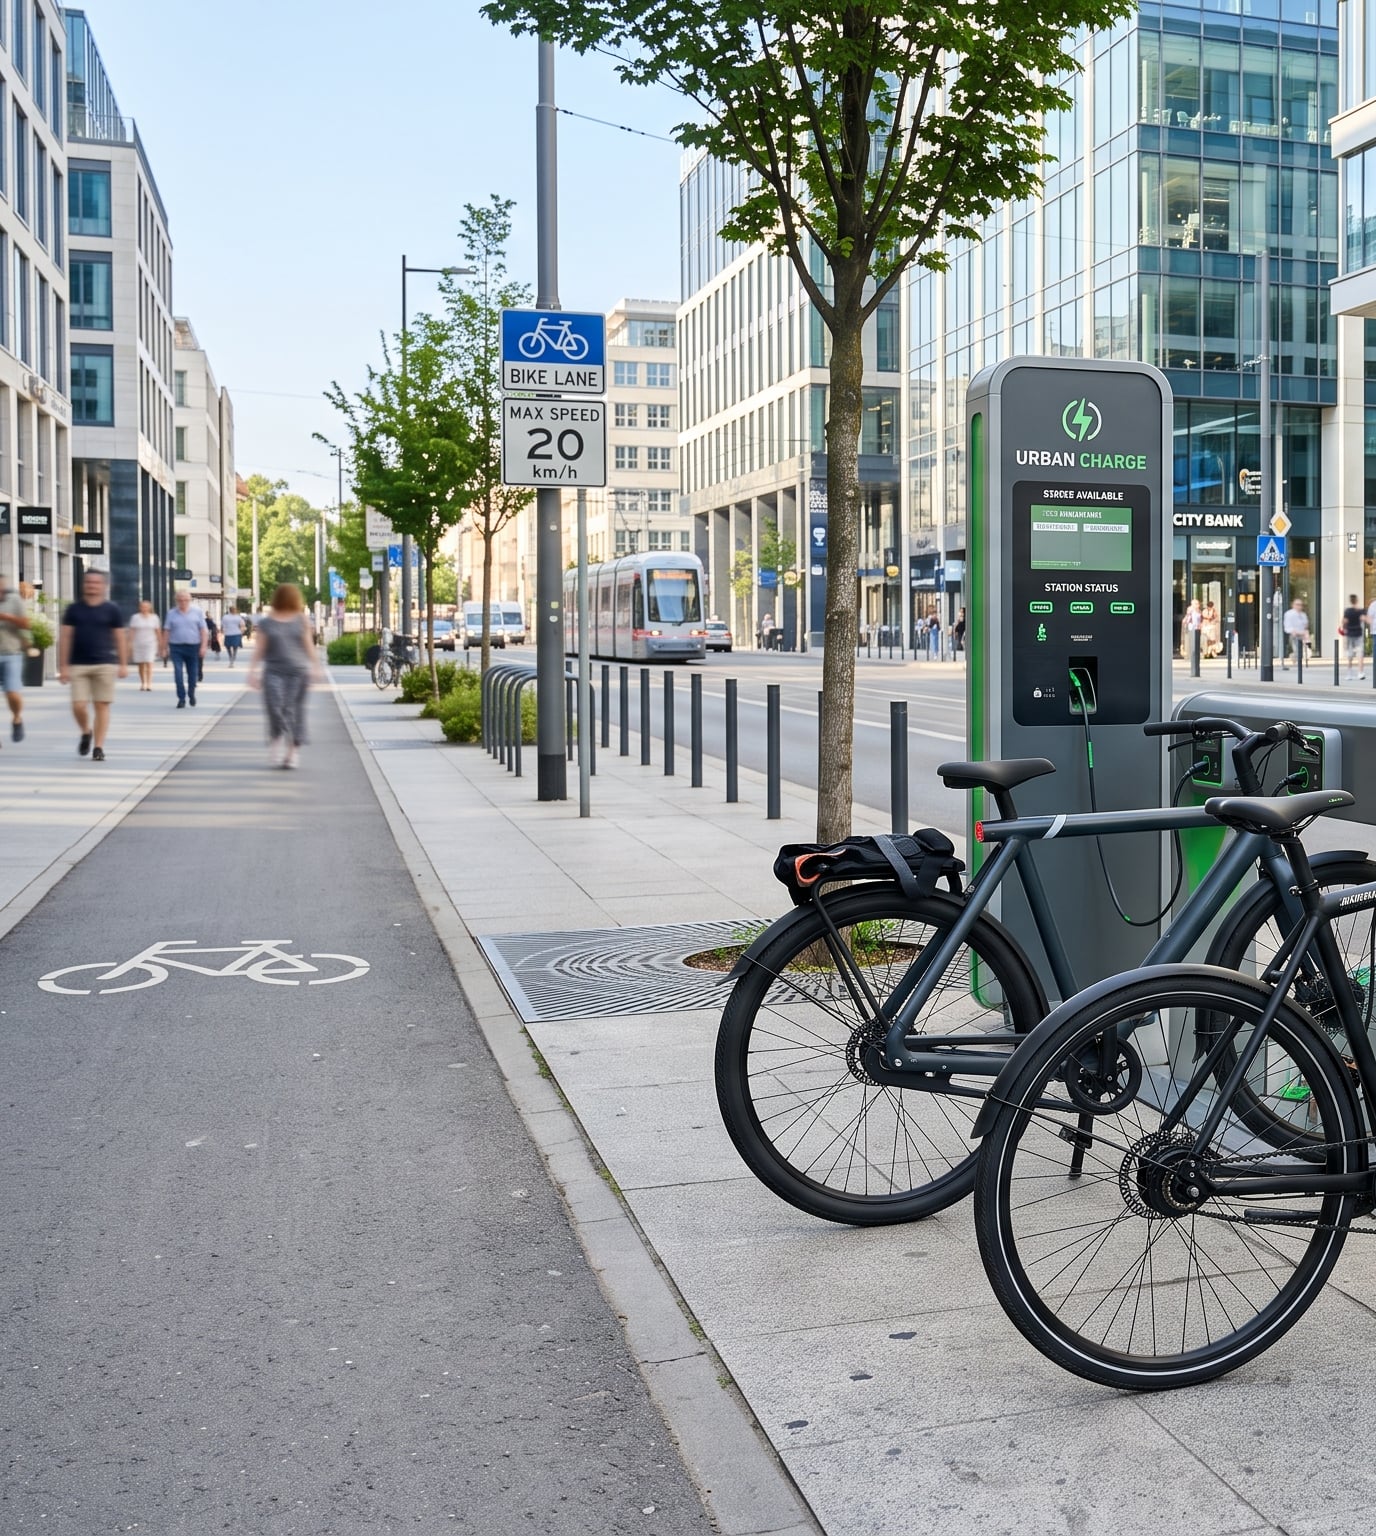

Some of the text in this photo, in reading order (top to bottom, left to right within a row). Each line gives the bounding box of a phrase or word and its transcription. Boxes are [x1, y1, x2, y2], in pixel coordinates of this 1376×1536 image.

[510, 368, 598, 387] BIKE LANE
[510, 406, 600, 422] MAX SPEED
[527, 427, 584, 461] 20
[1016, 450, 1147, 470] URBAN CHARGE
[533, 464, 577, 479] km/h
[1076, 490, 1124, 501] AVAILABLE
[1172, 513, 1244, 527] CITY BANK
[1044, 583, 1119, 593] STATION STATUS
